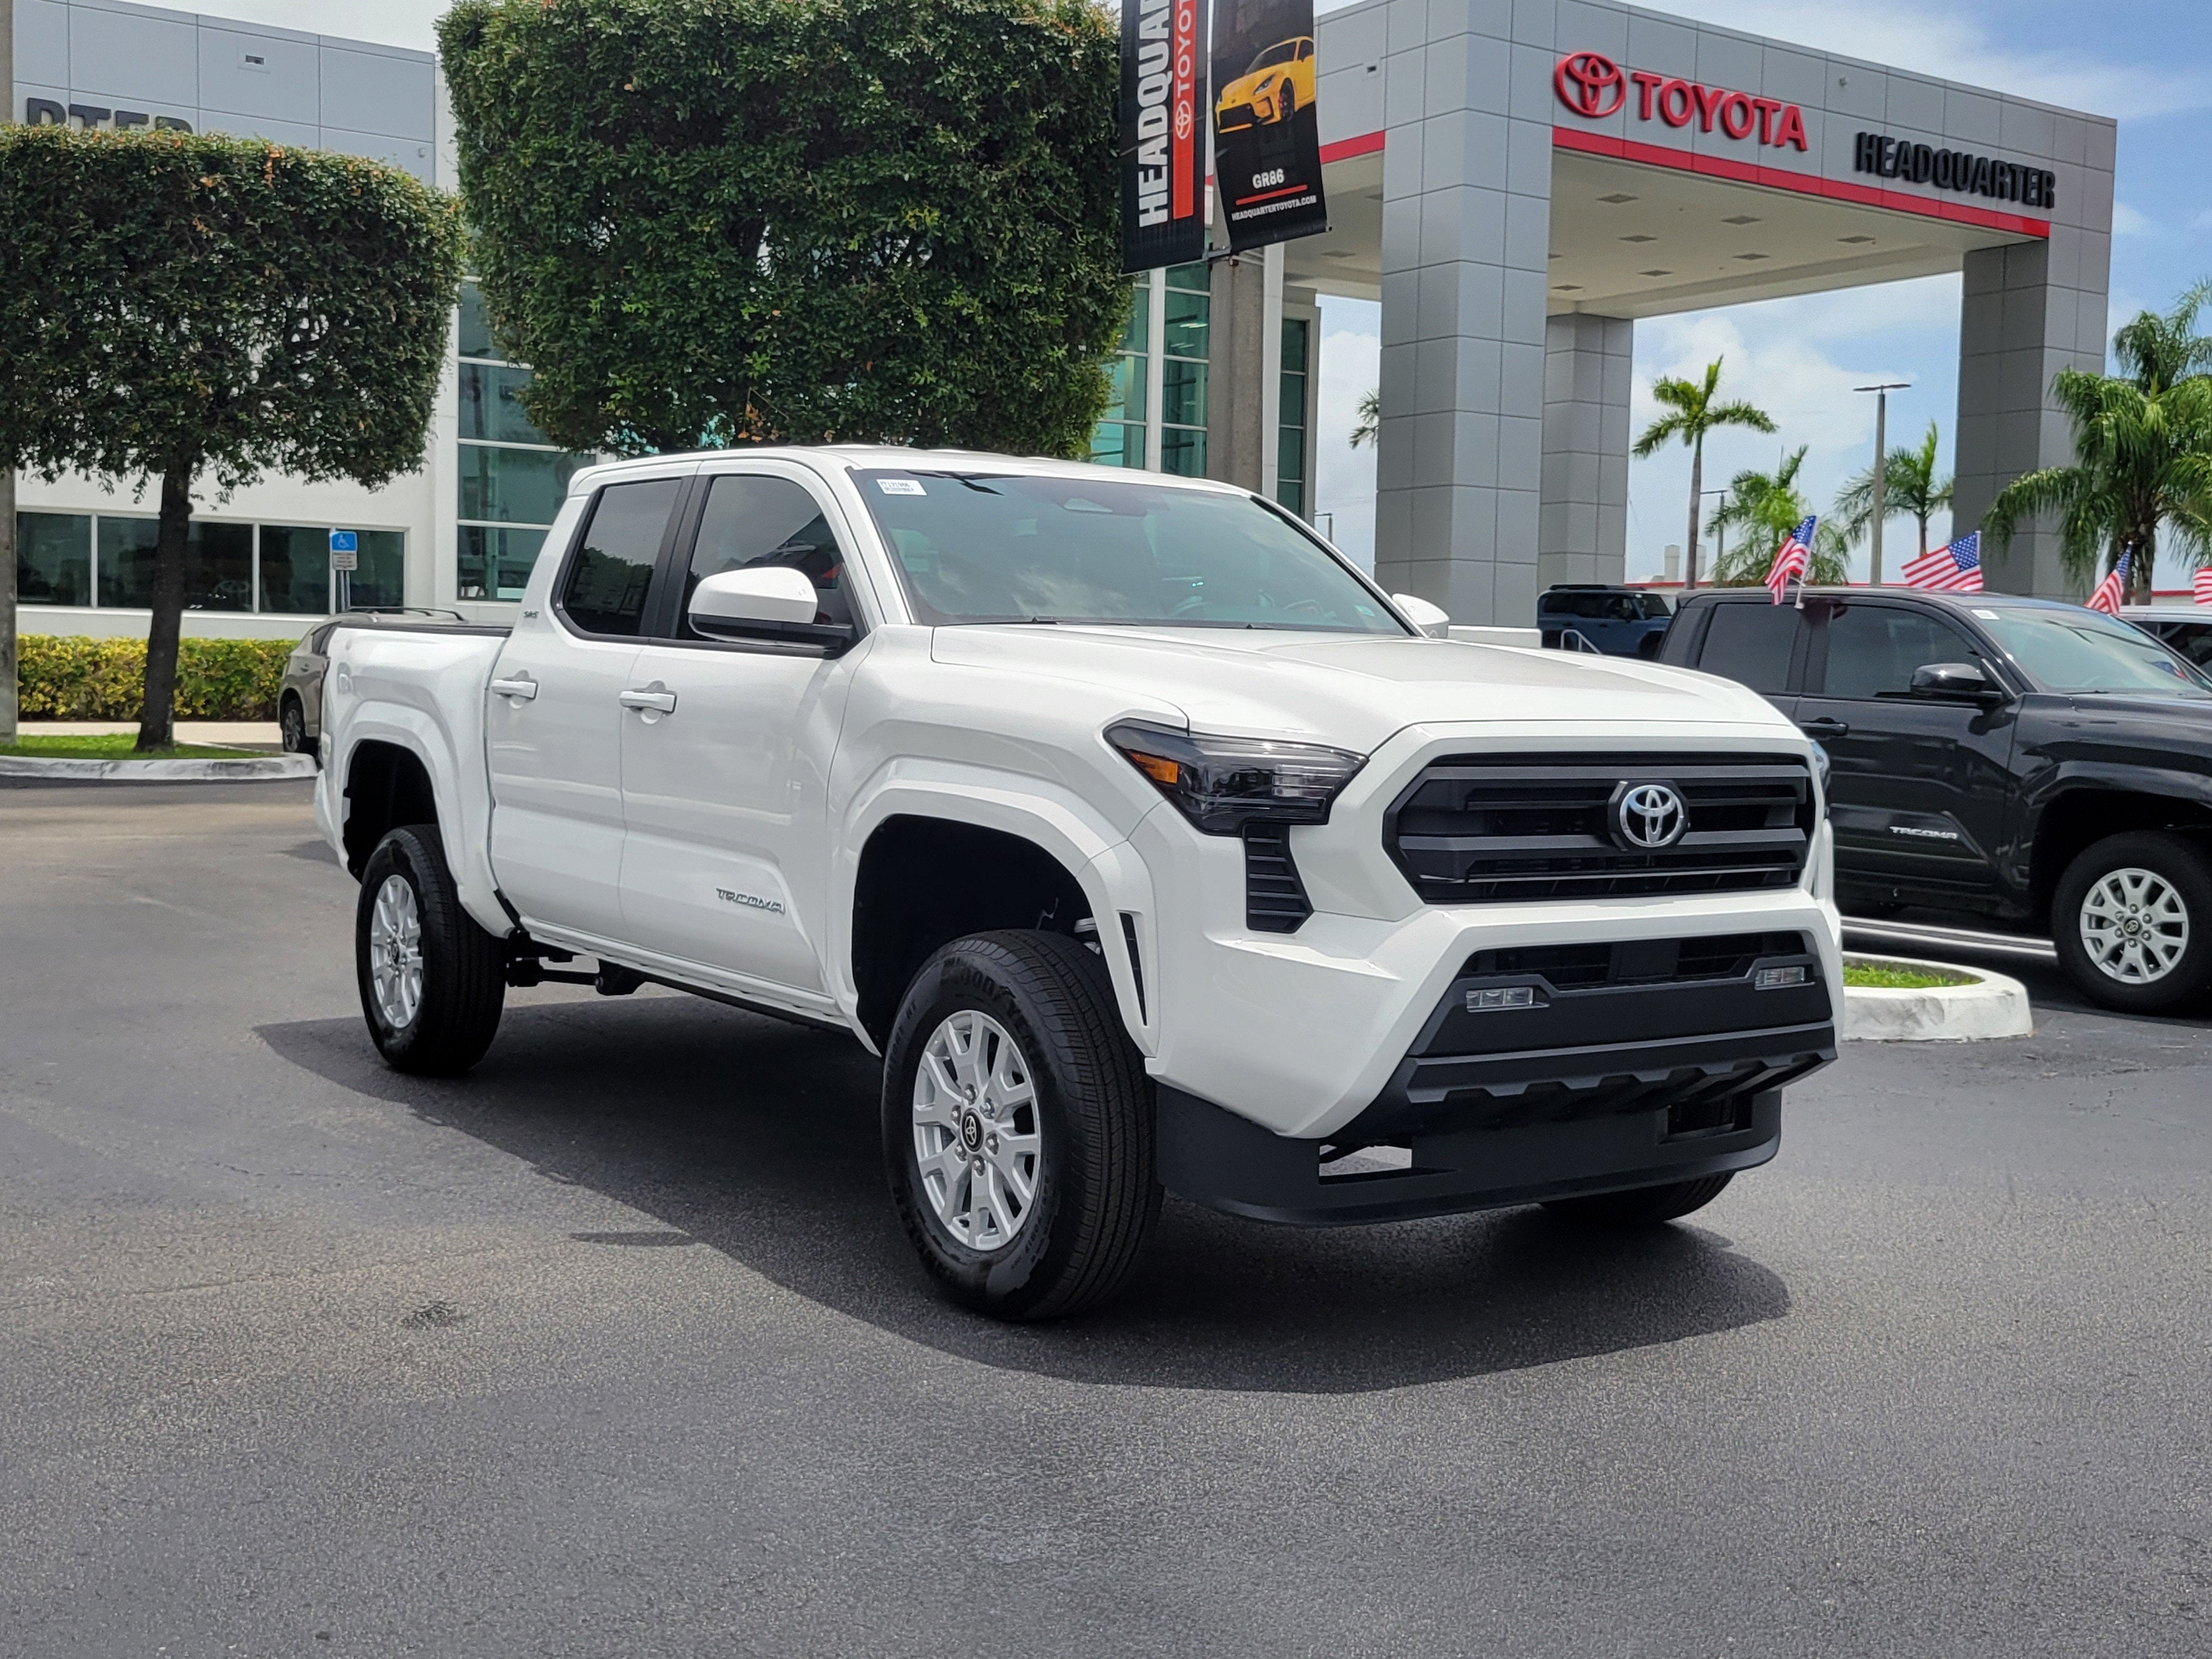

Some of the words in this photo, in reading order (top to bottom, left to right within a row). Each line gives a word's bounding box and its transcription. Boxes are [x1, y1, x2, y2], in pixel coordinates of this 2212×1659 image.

[1632, 71, 1808, 151] TOYOTA
[1252, 168, 1284, 189] GR86
[1854, 132, 2055, 208] HEADQUARTER
[1232, 195, 1317, 221] HEADQUARTERTOYOTA.COM
[1889, 826, 1959, 840] TACOMA
[715, 887, 786, 915] TACOMA
